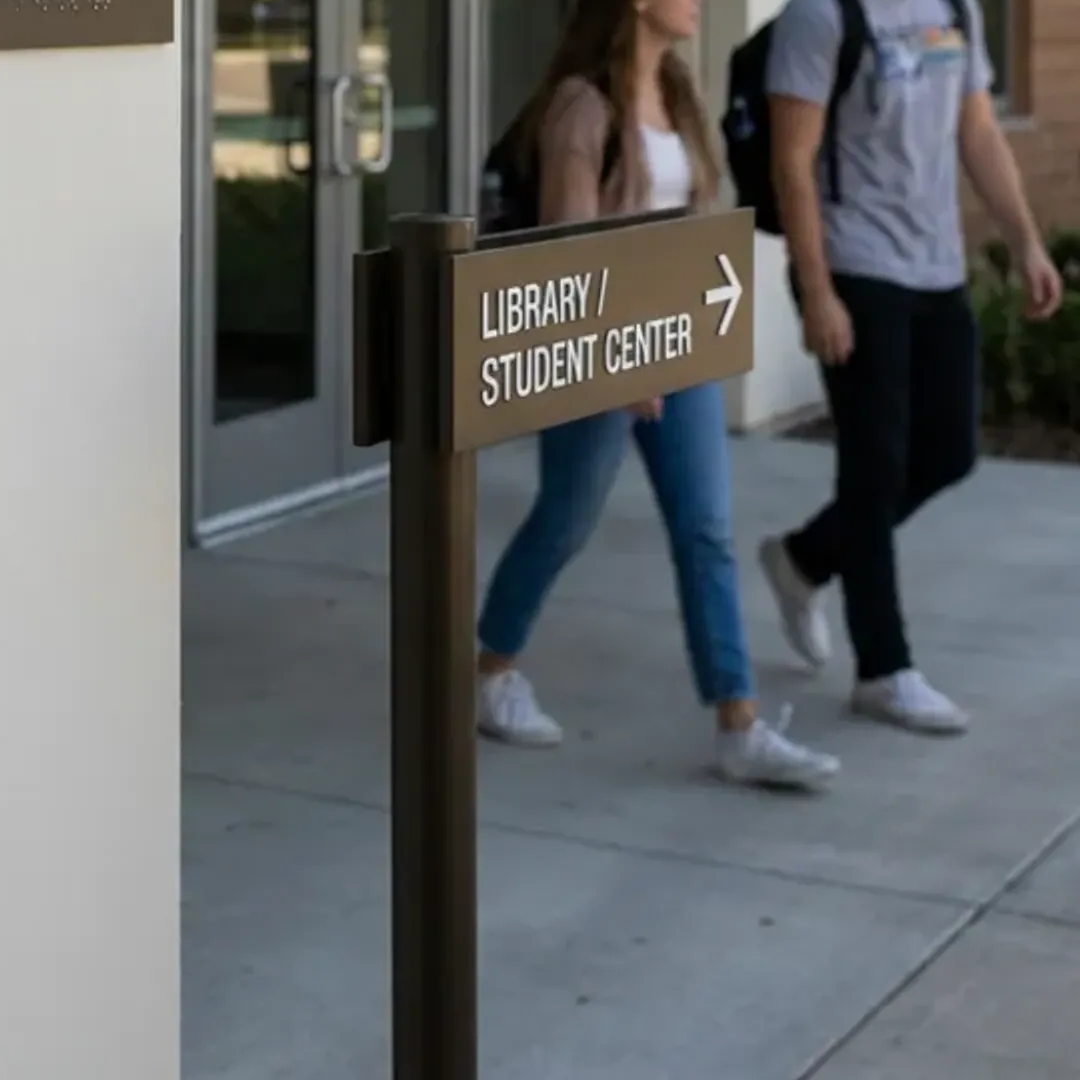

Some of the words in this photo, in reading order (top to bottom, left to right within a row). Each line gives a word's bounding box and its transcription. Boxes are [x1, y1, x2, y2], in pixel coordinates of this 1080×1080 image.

[482, 273, 592, 339] LIBRARY
[598, 268, 608, 315] /
[483, 334, 597, 405] STUDENT
[607, 314, 691, 373] CENTER
